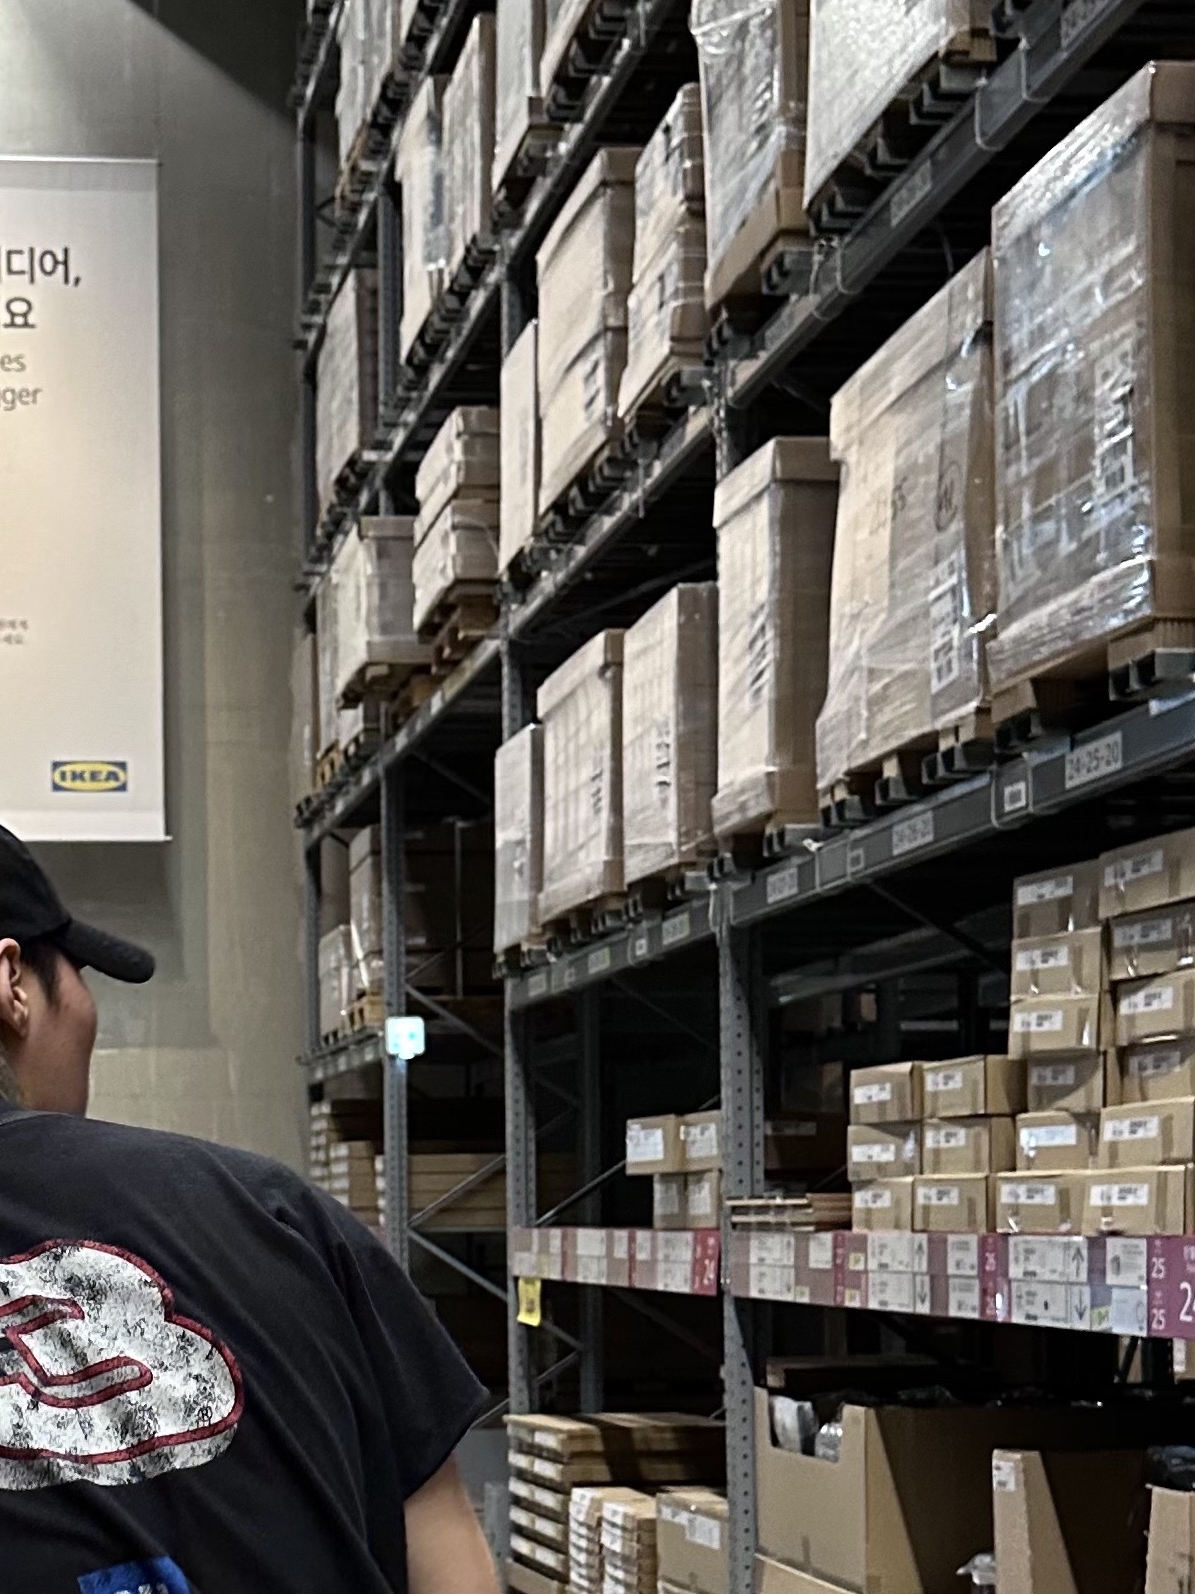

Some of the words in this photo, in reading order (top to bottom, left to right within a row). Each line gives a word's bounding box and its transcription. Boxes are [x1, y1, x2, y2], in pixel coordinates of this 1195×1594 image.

[1151, 1257, 1165, 1279] 25
[1179, 1280, 1195, 1322] 2
[1151, 1308, 1166, 1330] 25
